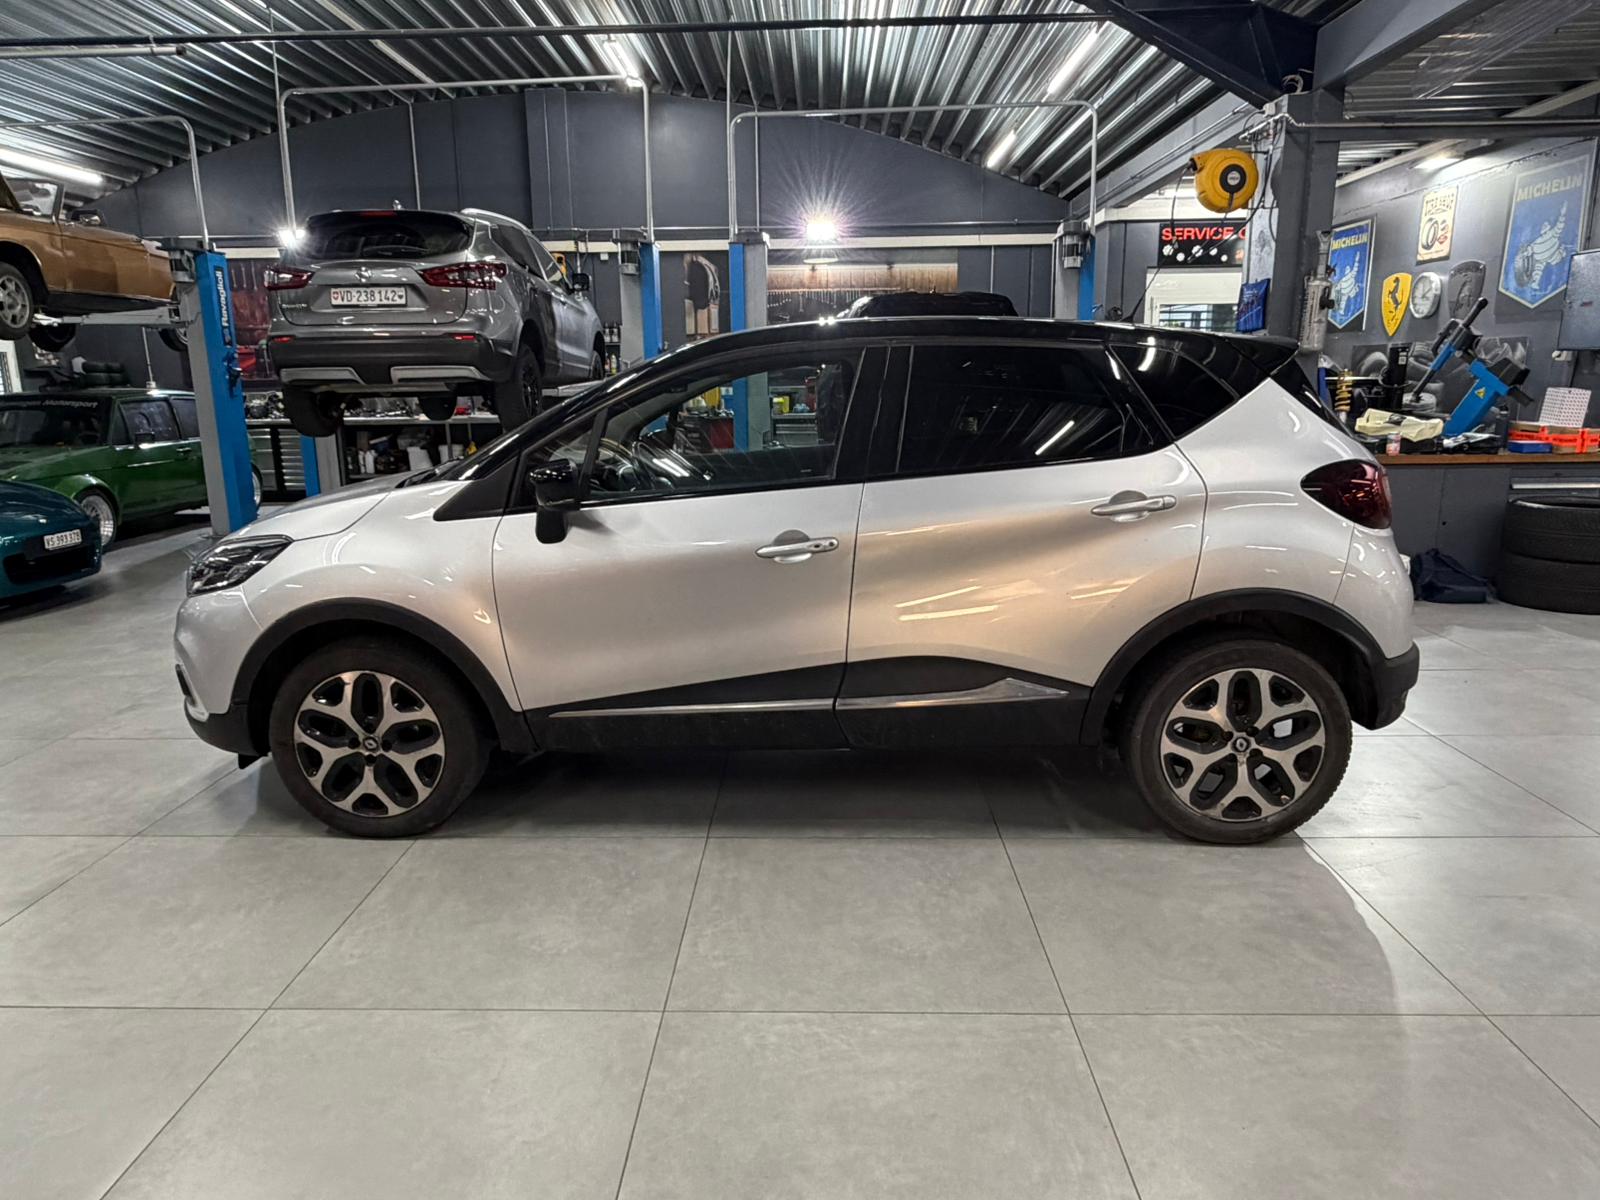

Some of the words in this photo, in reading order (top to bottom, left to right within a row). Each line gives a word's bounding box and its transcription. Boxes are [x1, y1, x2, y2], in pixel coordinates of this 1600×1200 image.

[1516, 174, 1583, 201] MICHELIN
[1162, 226, 1235, 241] SERVICE
[1331, 232, 1368, 250] MICHELIN
[214, 270, 229, 327] Ravaglioli
